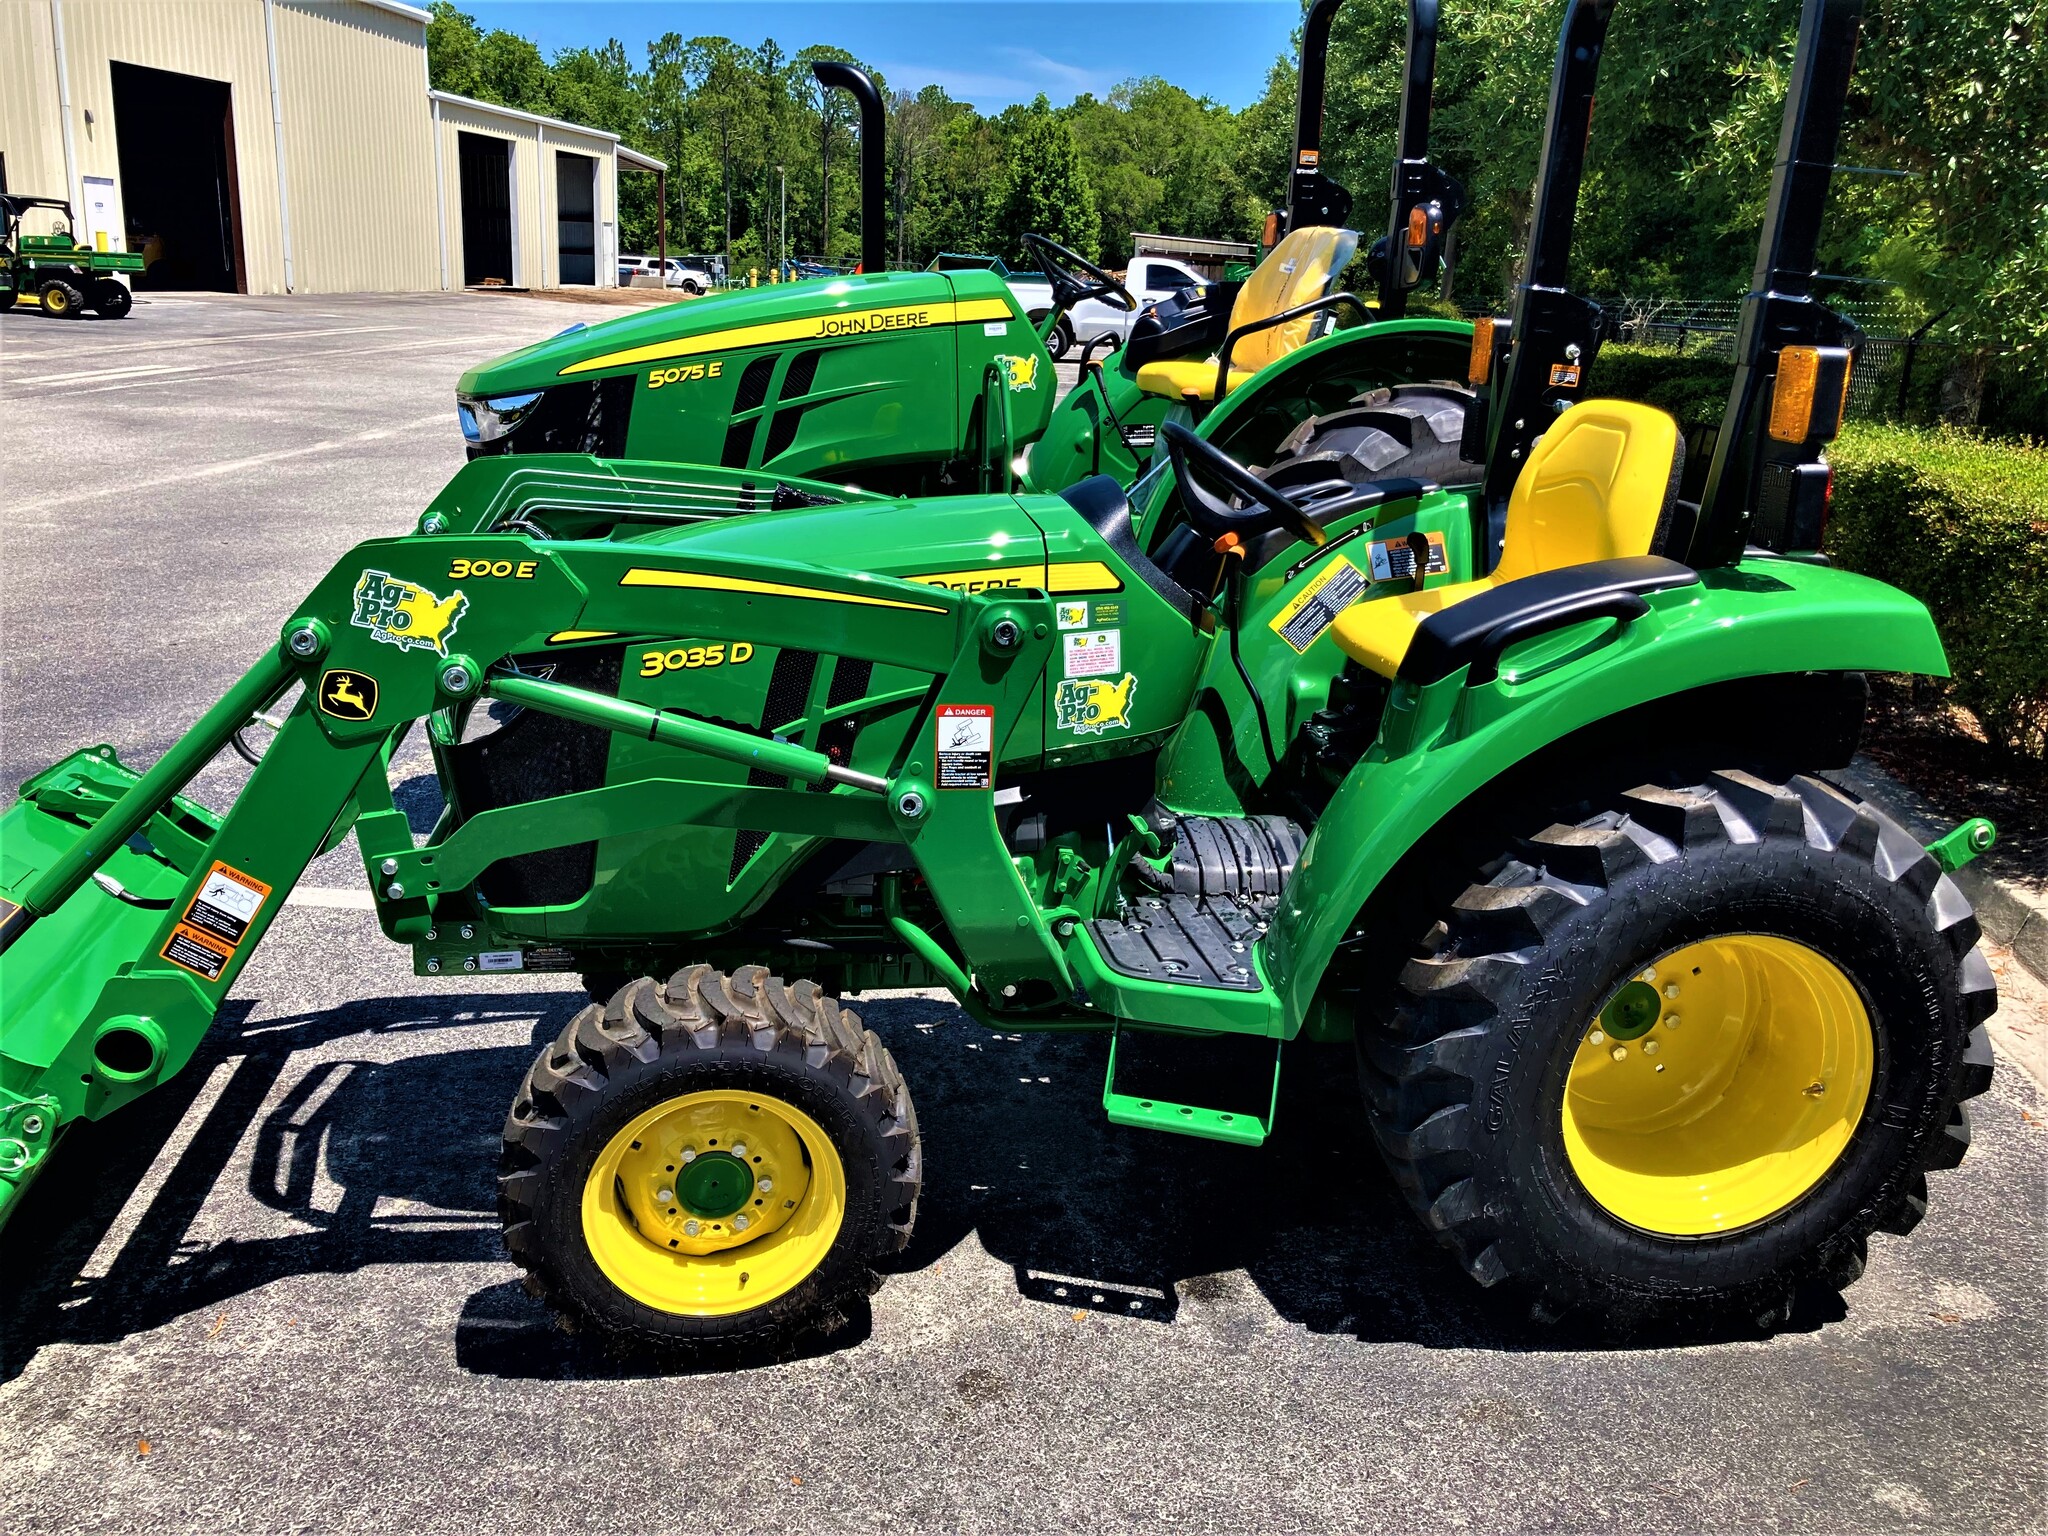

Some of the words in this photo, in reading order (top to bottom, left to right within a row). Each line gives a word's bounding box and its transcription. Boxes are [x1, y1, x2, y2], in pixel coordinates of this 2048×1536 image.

[816, 318, 865, 335] JOHN
[870, 311, 928, 329] DEERE
[648, 364, 704, 389] 5075
[708, 361, 723, 378] E
[447, 559, 513, 579] 300
[515, 561, 538, 579] E
[358, 573, 415, 609] Ag-
[1297, 576, 1326, 605] CAUTION
[354, 597, 412, 631] Pro
[374, 630, 434, 648] AgProCo.com
[640, 645, 725, 676] 3035
[730, 642, 753, 663] D
[1060, 683, 1098, 706] Ag-
[1061, 703, 1099, 724] Pro
[1076, 720, 1119, 732] AgProCo.com
[228, 870, 264, 892] WARNING
[192, 933, 227, 954] WARNING
[660, 1059, 858, 1130] MARATHONER
